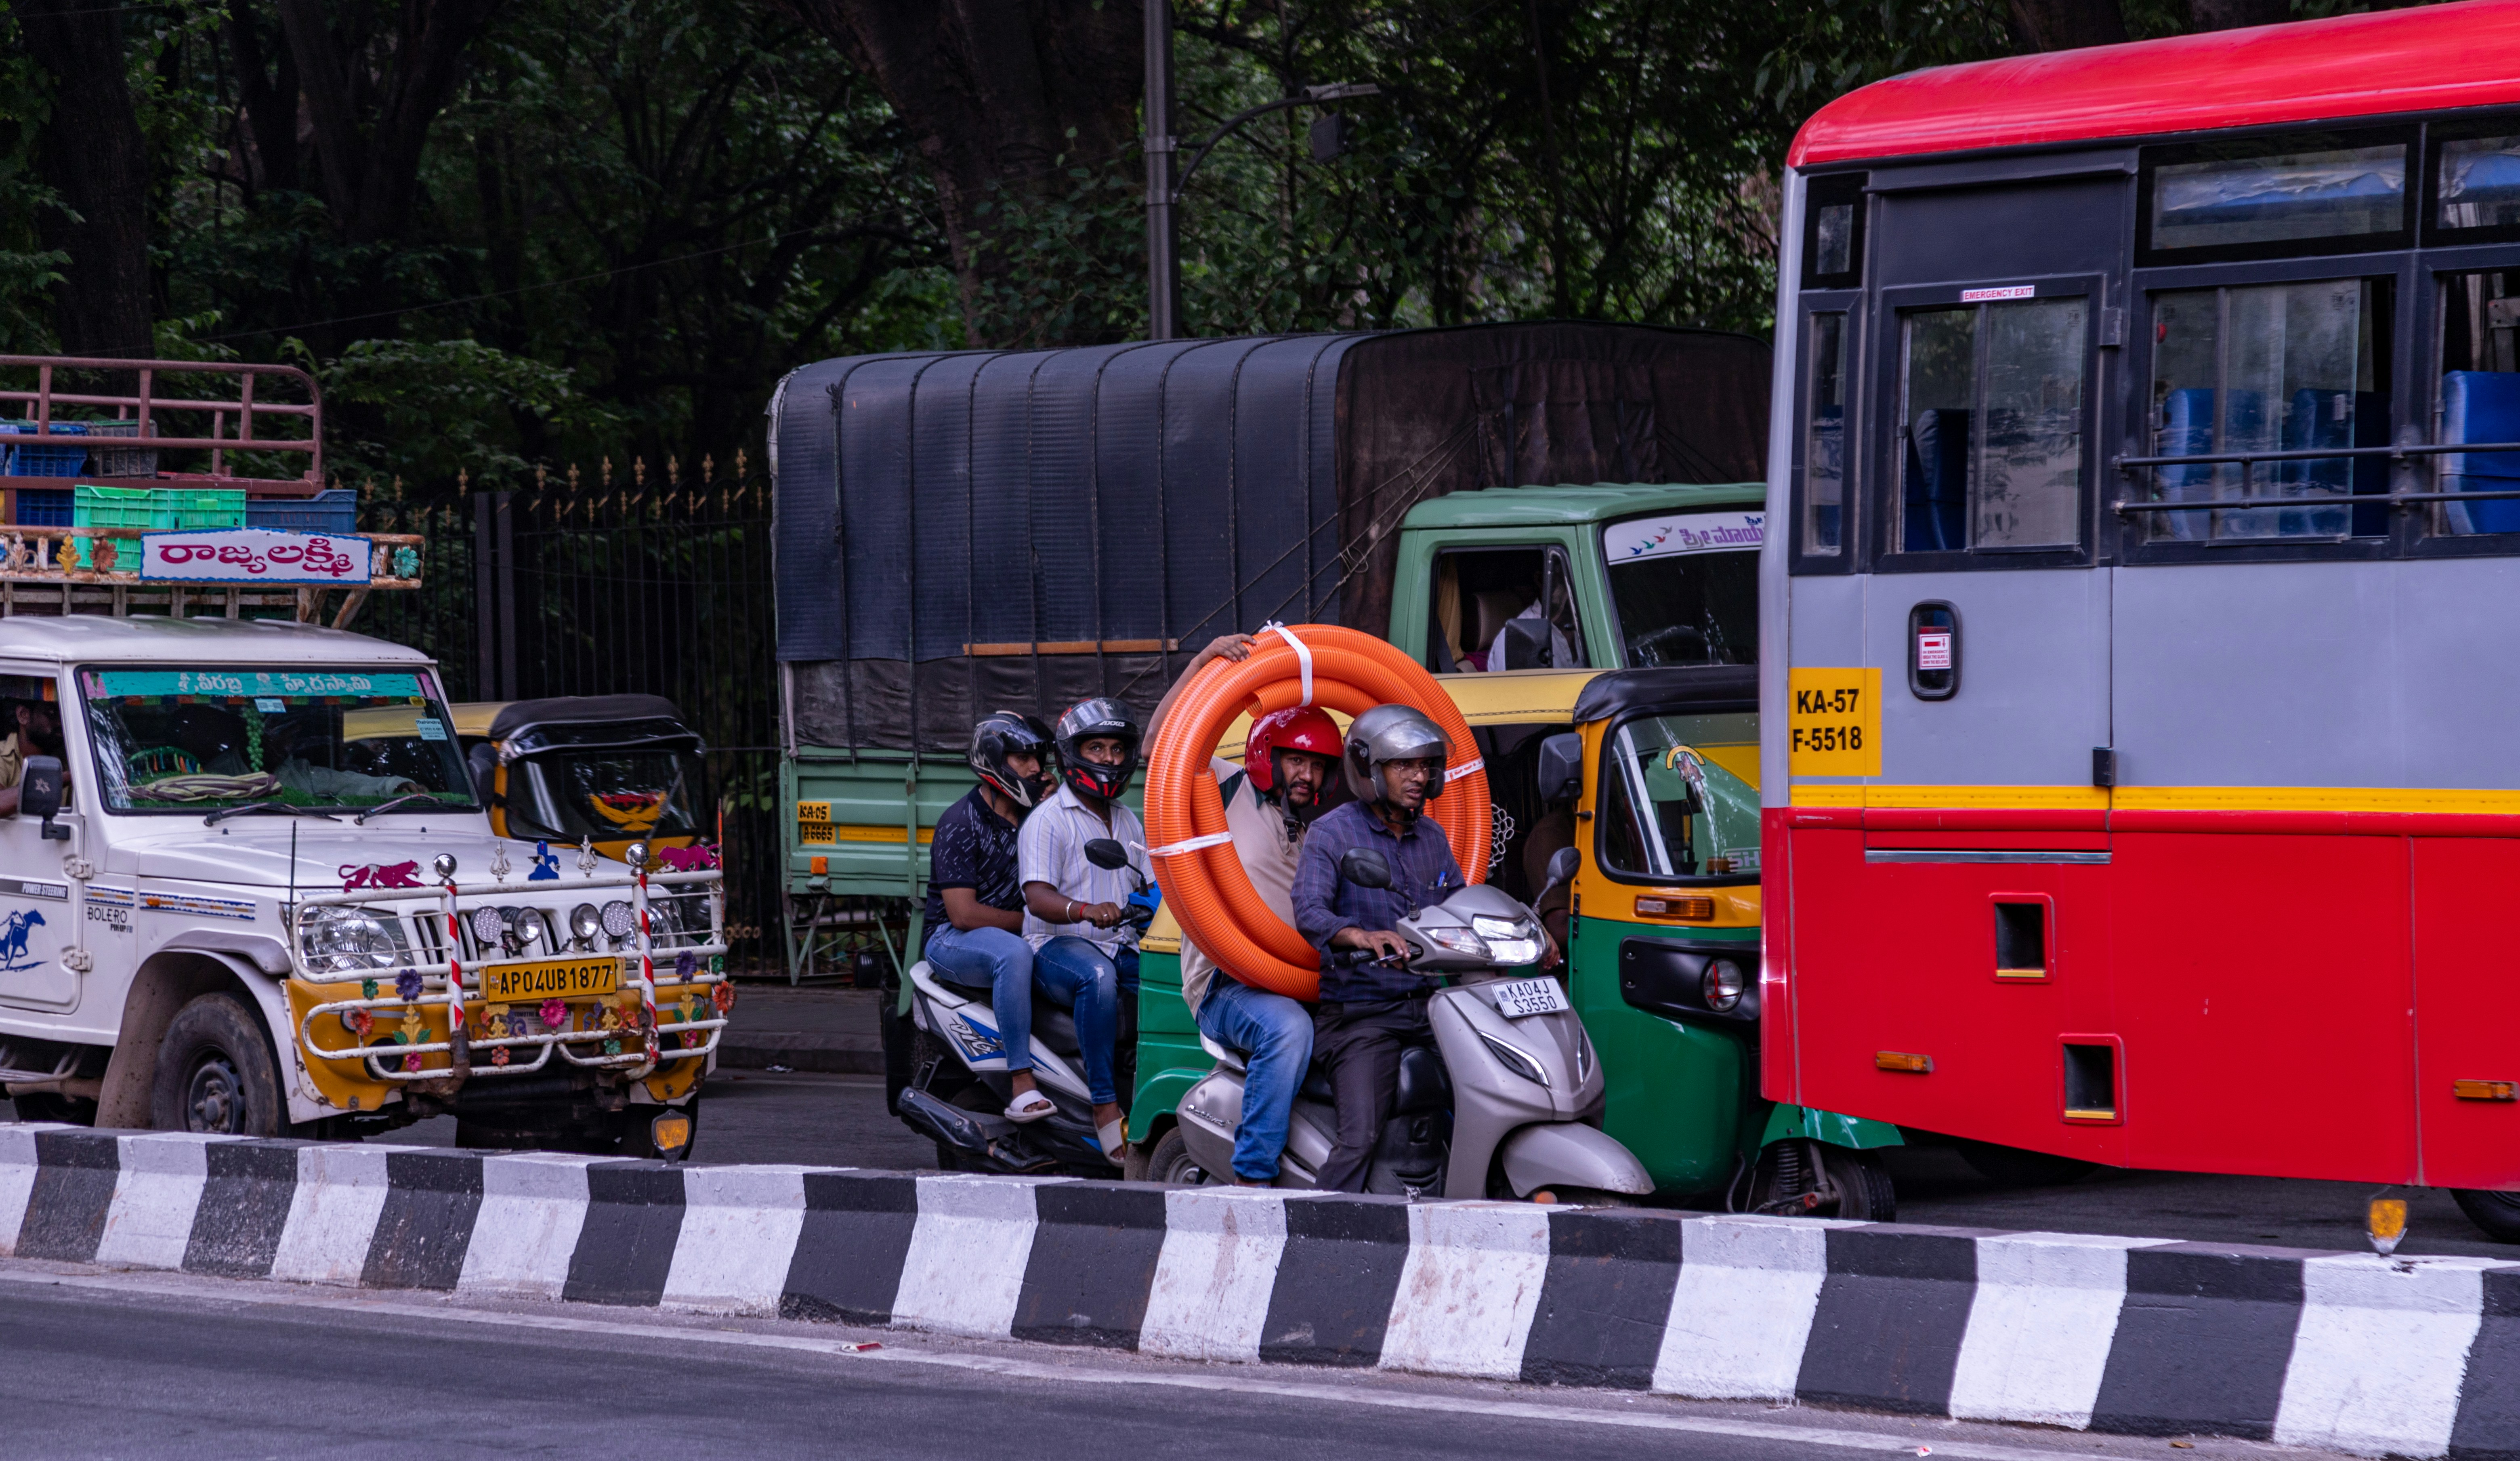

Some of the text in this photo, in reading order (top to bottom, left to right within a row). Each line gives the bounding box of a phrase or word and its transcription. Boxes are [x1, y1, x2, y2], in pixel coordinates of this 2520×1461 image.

[1965, 287, 2033, 300] EMERGENCY EXIT
[1798, 688, 1860, 714] KA-57
[1793, 725, 1863, 753] F-5518
[22, 883, 66, 898] POWER STEERING
[87, 907, 128, 923] BOLERO
[500, 965, 611, 994] AP04UB1877
[1506, 980, 1550, 999] KA04J
[1514, 995, 1557, 1013] S3550
